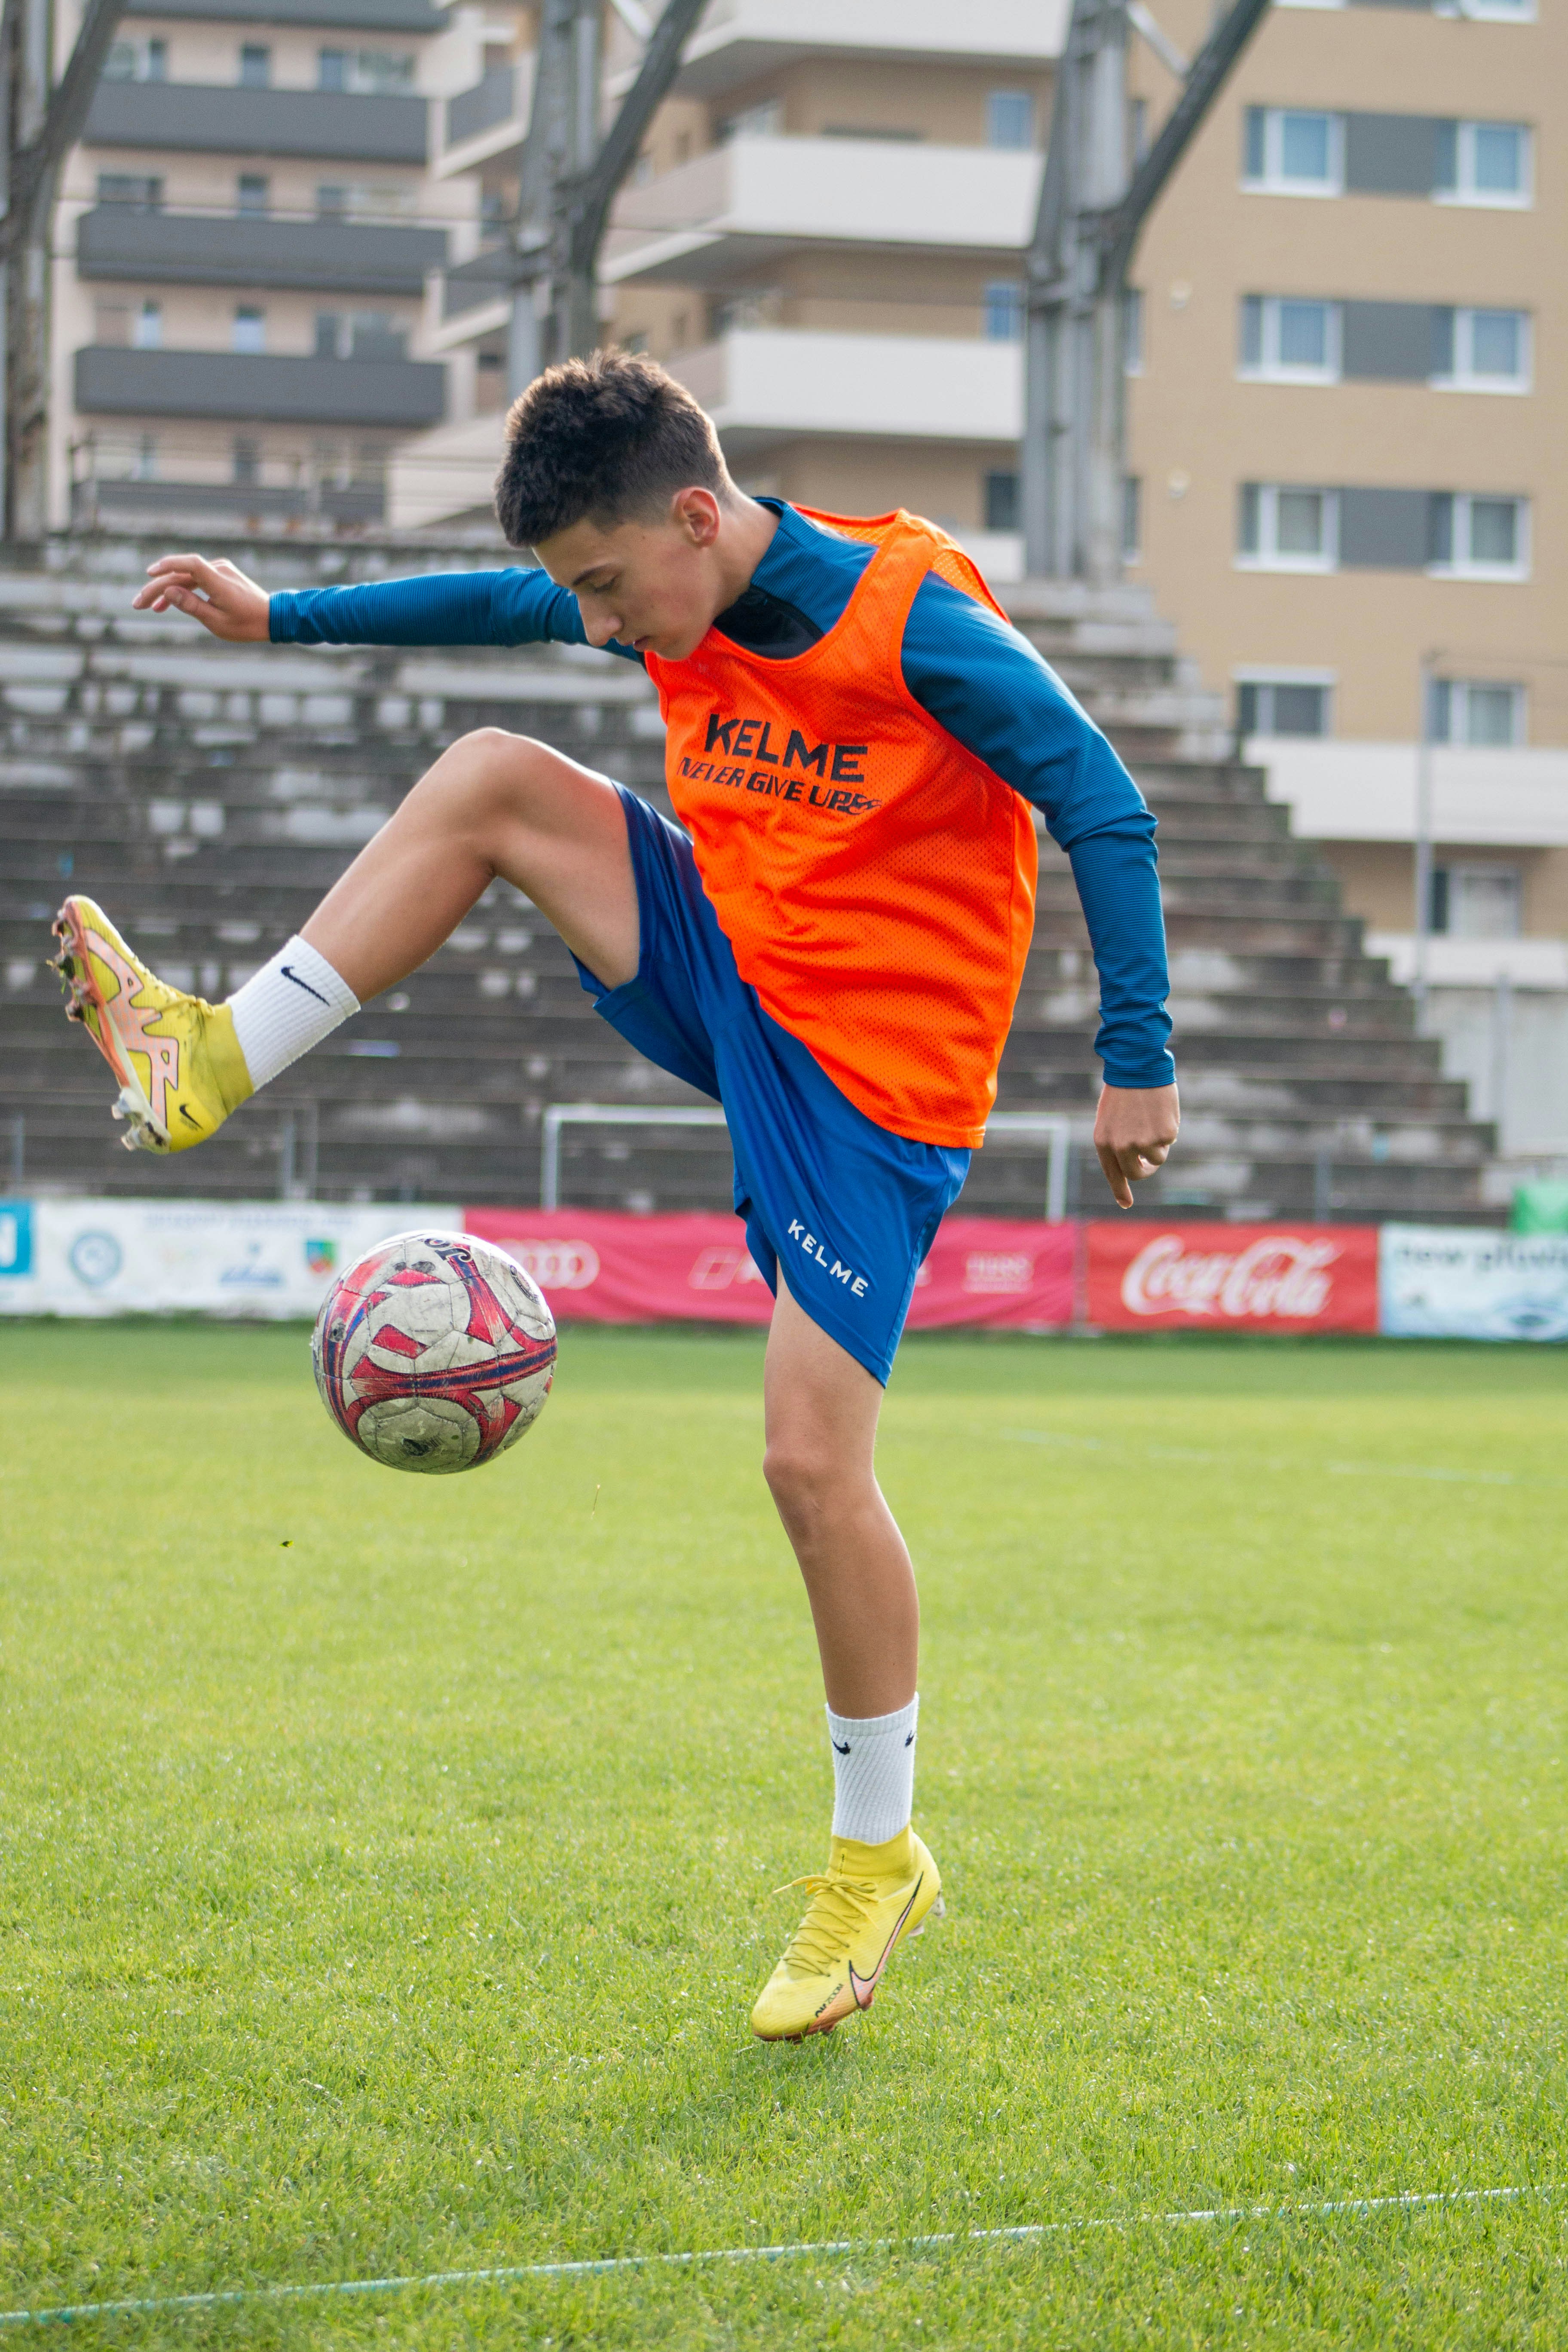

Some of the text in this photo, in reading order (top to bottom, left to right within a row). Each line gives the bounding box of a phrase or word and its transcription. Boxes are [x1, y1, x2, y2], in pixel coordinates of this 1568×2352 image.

[677, 756, 746, 787] NEVER
[746, 772, 806, 801] GIVE
[704, 714, 868, 783] KELME
[787, 1219, 868, 1298] KELME
